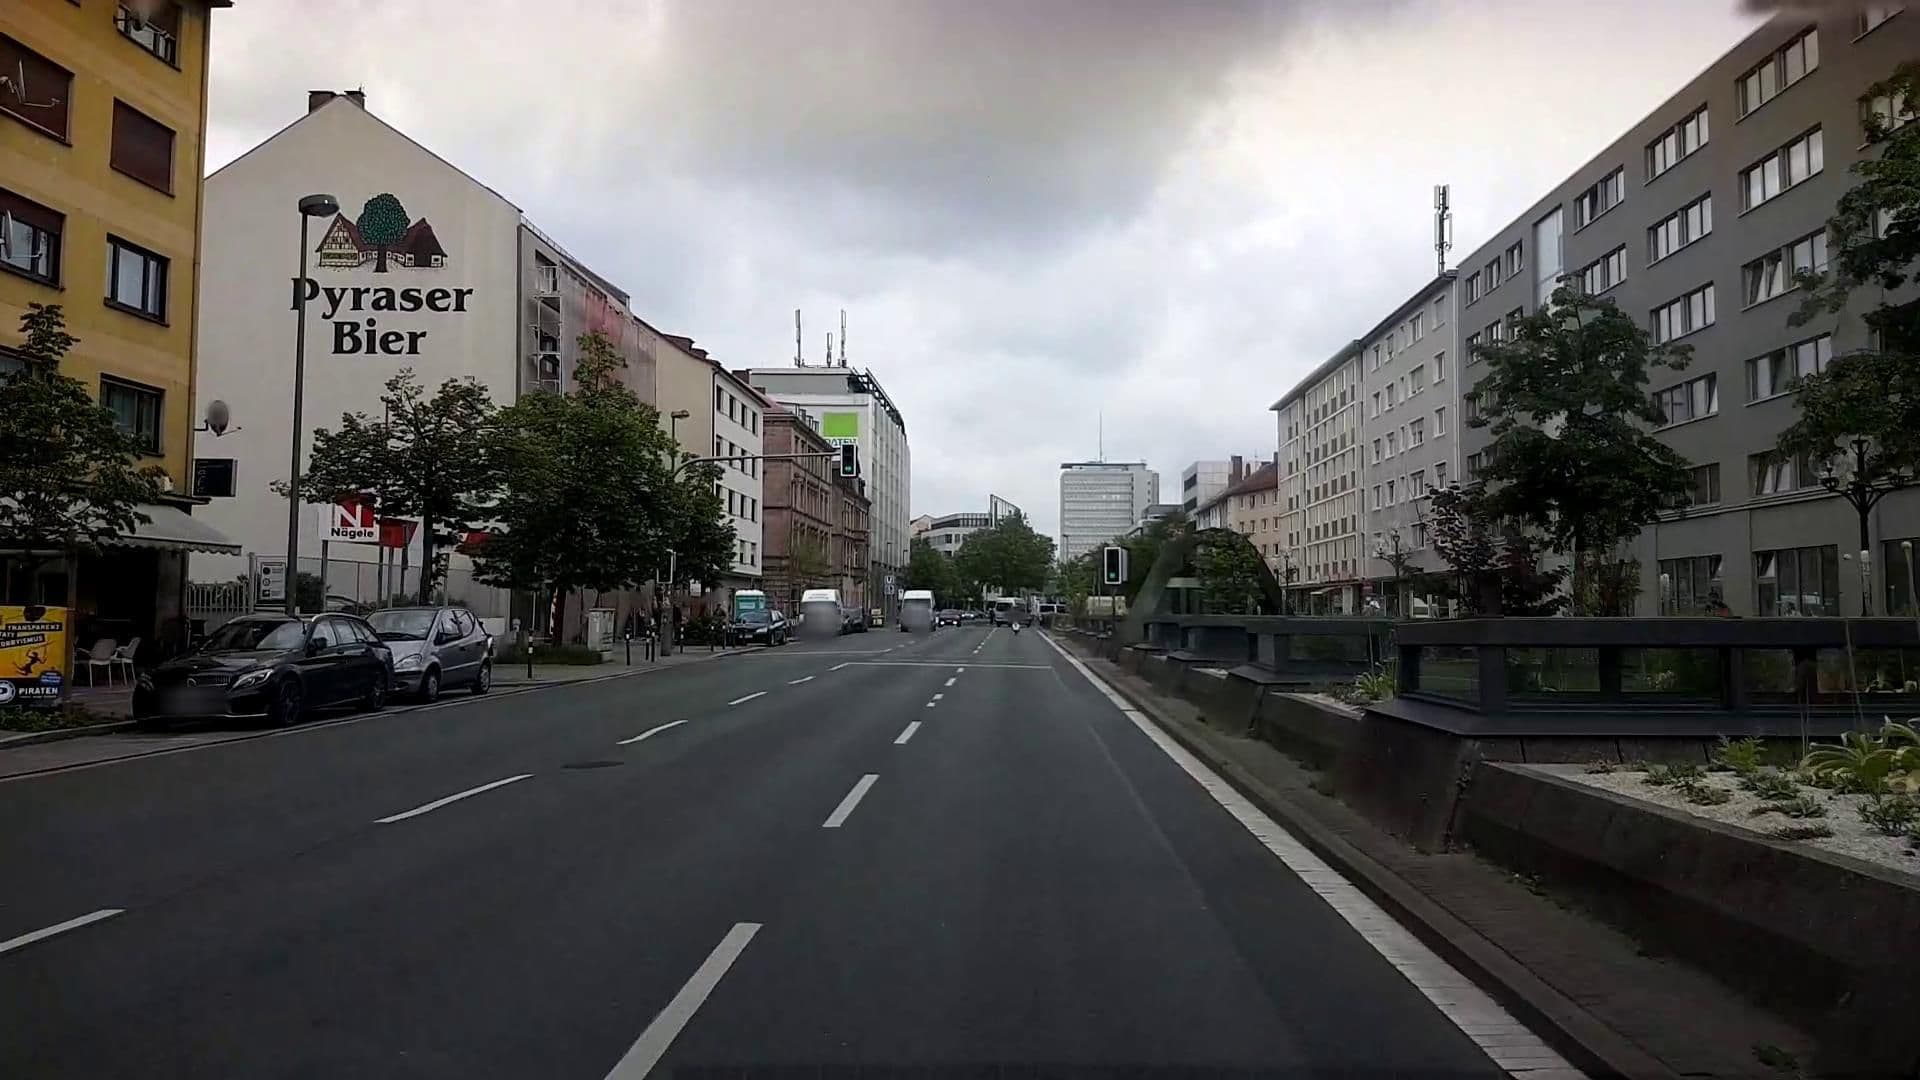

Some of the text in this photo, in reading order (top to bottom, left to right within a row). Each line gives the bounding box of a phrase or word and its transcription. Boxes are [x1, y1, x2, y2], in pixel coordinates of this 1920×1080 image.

[290, 277, 473, 319] Pyraser
[332, 317, 427, 355] Bier
[331, 527, 374, 540] Nägele
[8, 624, 60, 632] TRANSPARENZ
[18, 687, 58, 695] PIRATEN
